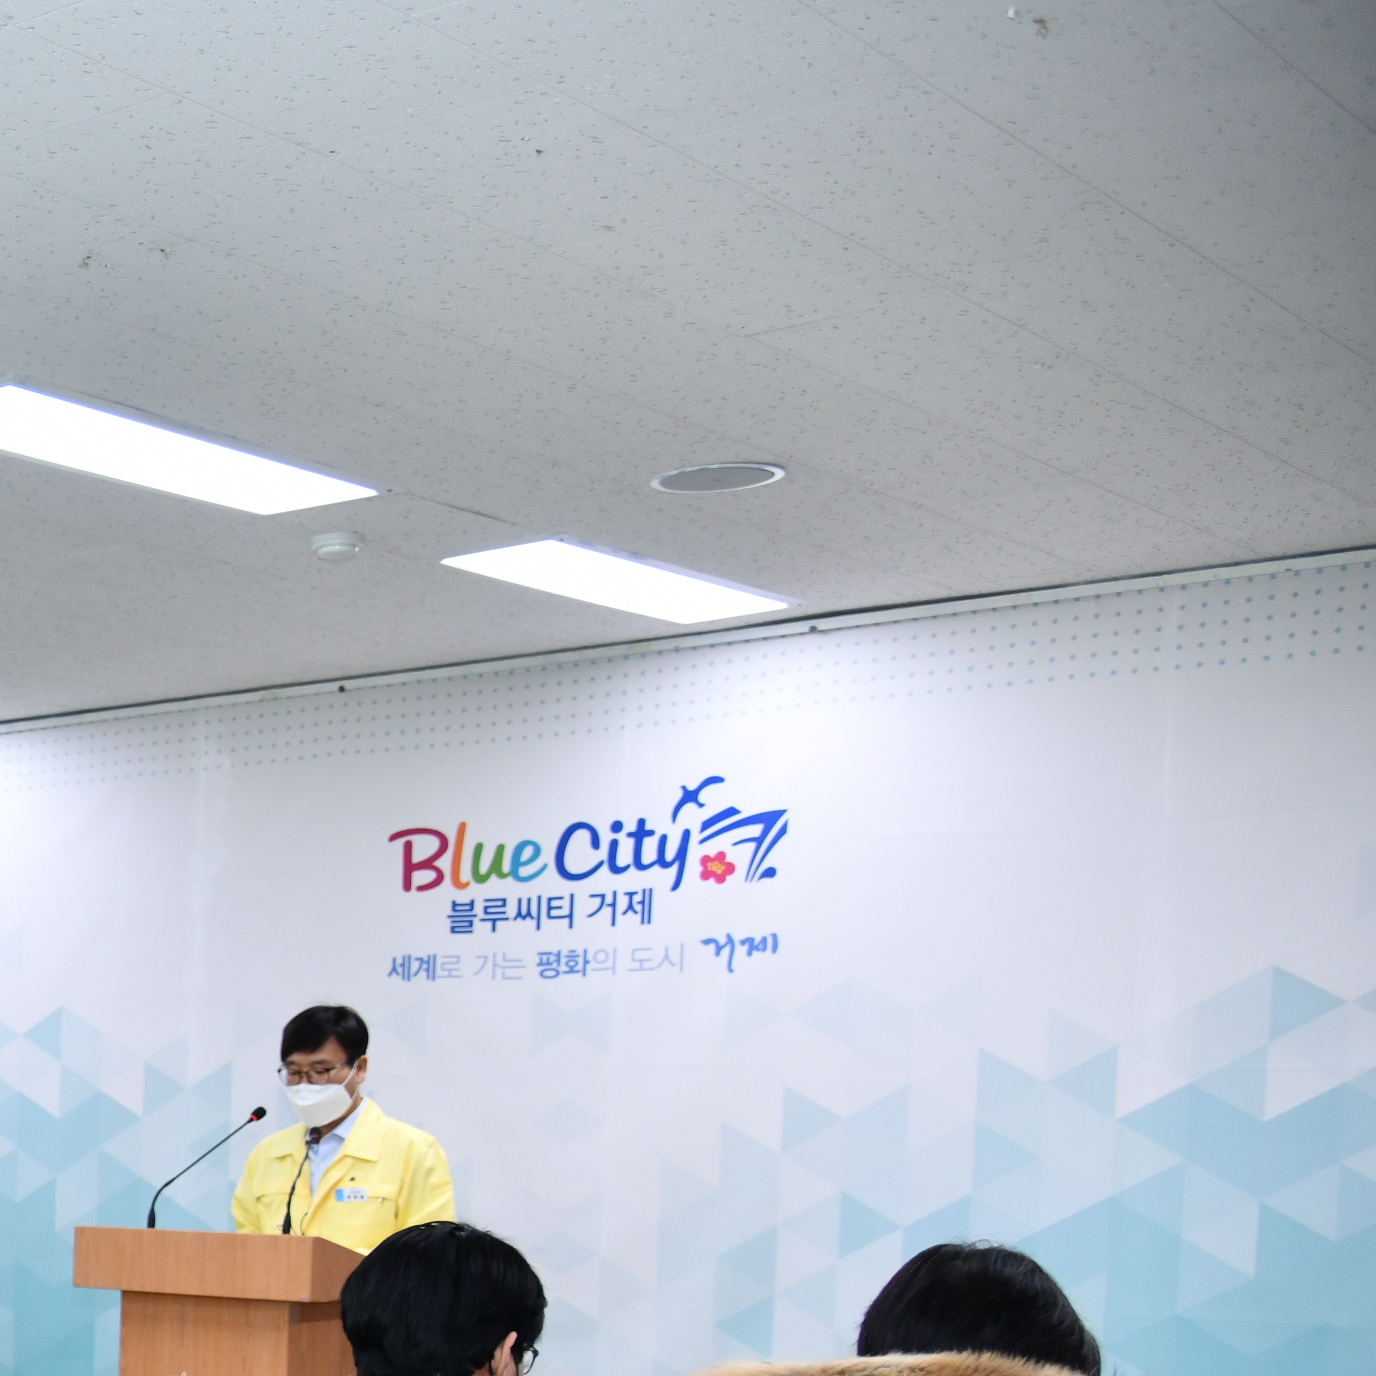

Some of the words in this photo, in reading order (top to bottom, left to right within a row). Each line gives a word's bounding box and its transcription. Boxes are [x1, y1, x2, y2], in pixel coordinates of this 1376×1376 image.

[388, 821, 548, 892] Blue
[554, 817, 691, 892] City
[447, 893, 575, 935] 블루씨티
[586, 887, 654, 928] 거제
[387, 953, 463, 983] 세계로
[473, 951, 527, 981] 가는
[535, 946, 618, 980] 평화의
[626, 943, 686, 976] 도시
[700, 932, 779, 974] 거제
